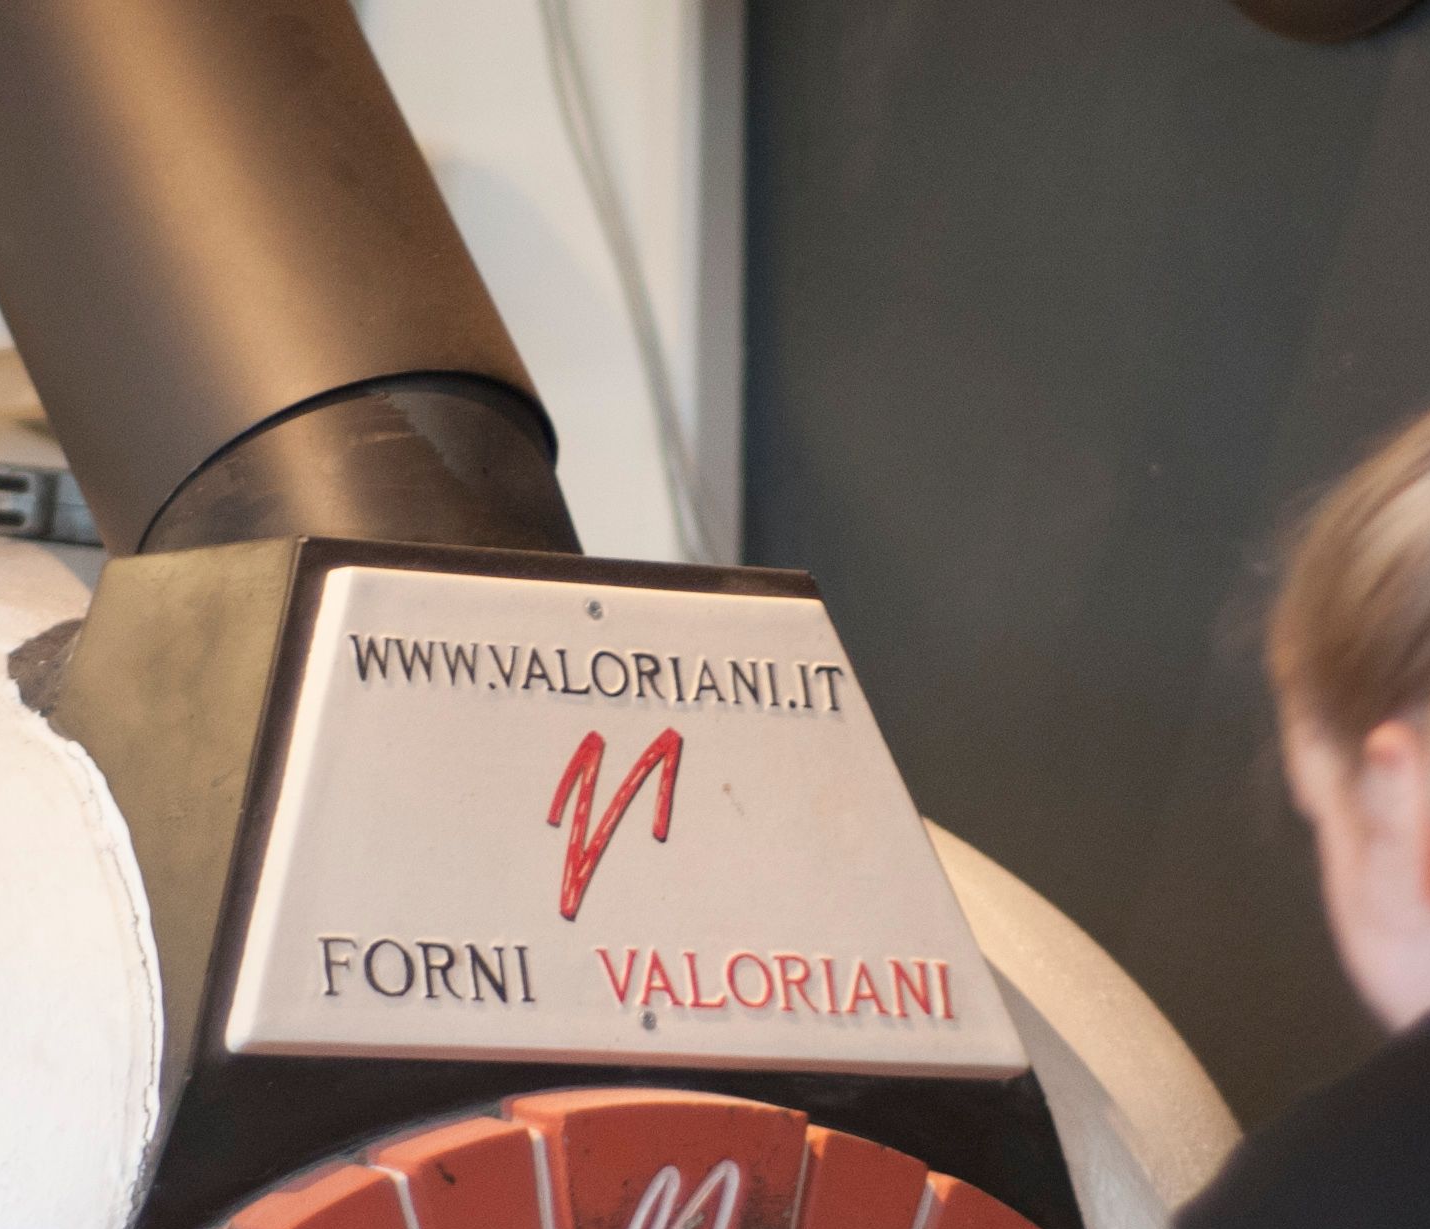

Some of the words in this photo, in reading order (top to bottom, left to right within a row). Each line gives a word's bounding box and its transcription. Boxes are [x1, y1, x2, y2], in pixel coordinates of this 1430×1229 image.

[351, 634, 844, 711] WWW.VALORIANI.IT
[318, 937, 536, 1004] FORNI
[595, 947, 955, 1020] VALORIANI
